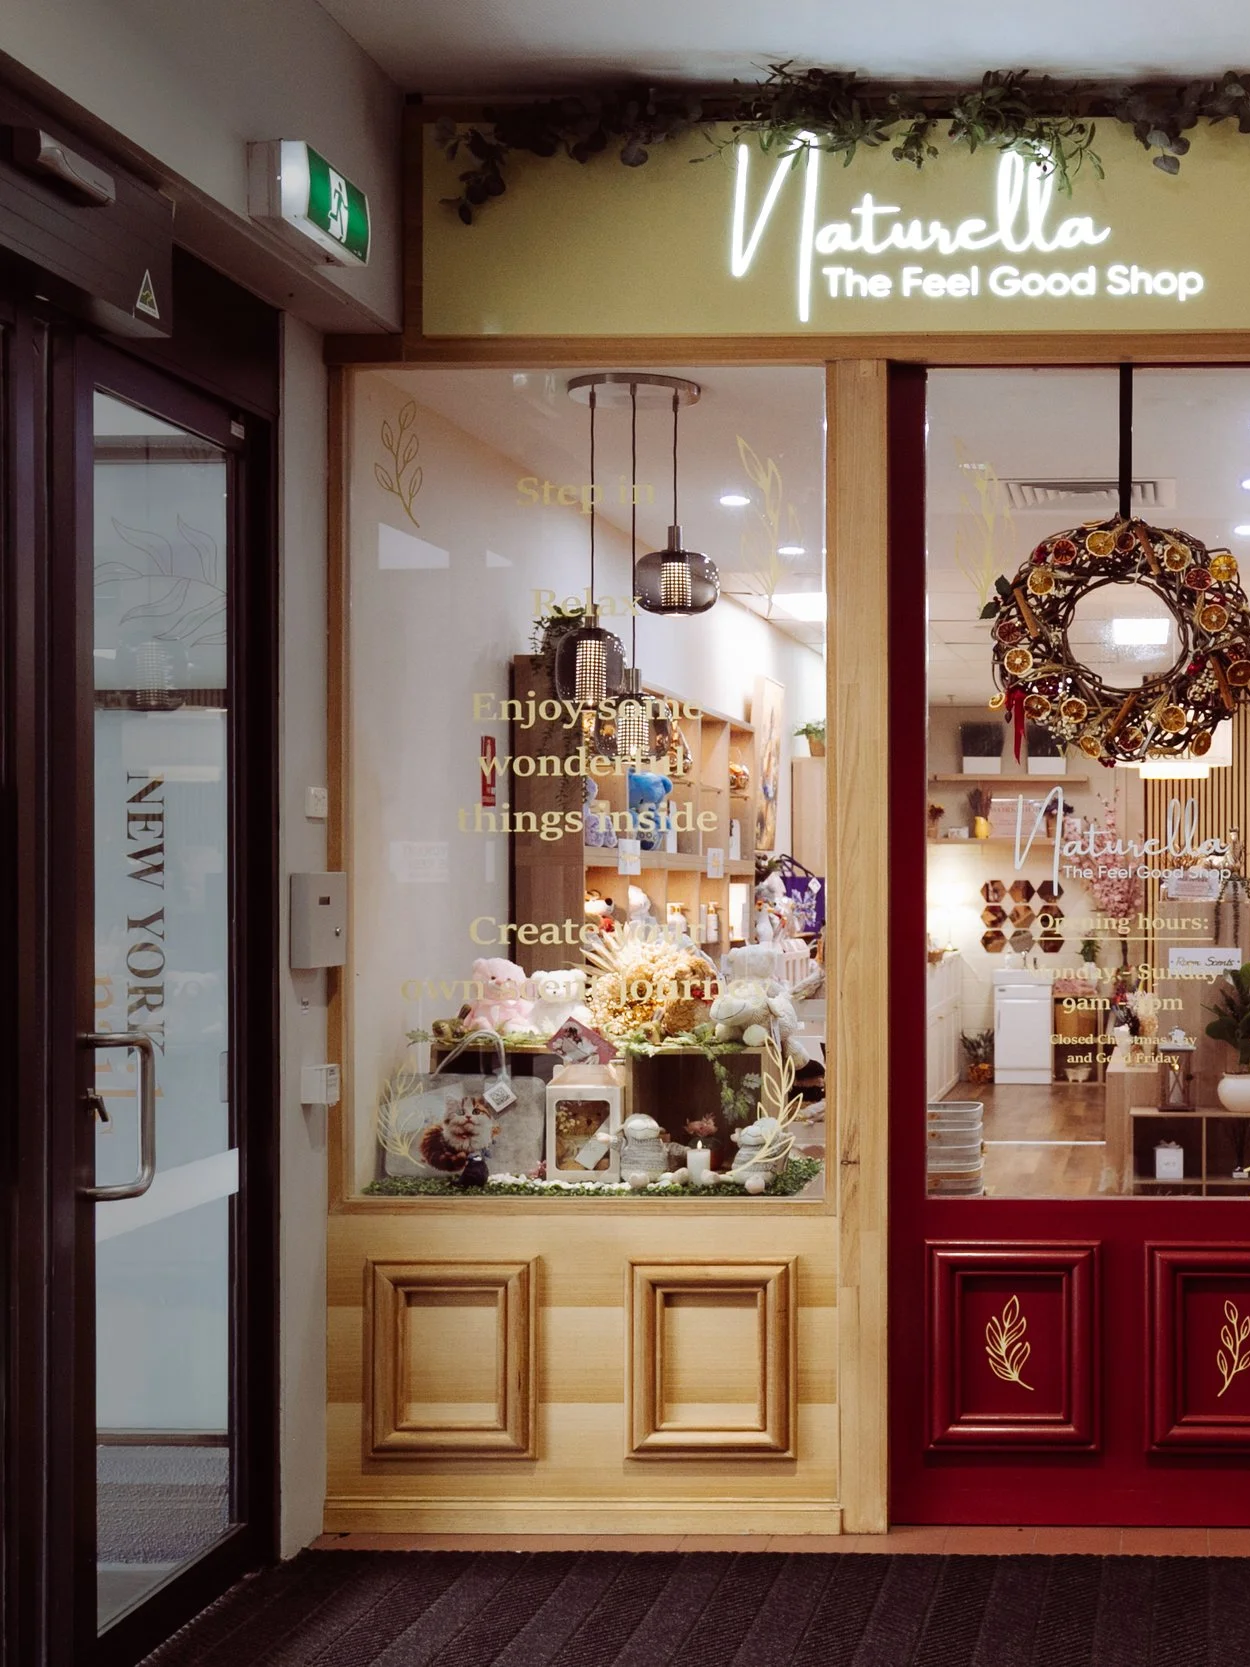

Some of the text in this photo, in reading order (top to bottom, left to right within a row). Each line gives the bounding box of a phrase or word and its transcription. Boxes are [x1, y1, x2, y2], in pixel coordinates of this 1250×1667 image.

[731, 131, 1112, 323] Naturella
[822, 264, 1205, 301] The Feel Good Shop
[516, 475, 656, 514] Step in
[530, 587, 643, 617] Relax
[472, 690, 705, 729] Enjoy some
[477, 746, 687, 777] wonderful
[457, 802, 718, 841] things inside
[1015, 786, 1230, 896] Naturella
[1063, 865, 1231, 883] The Feel Good Shop
[126, 771, 165, 1058] NEW YORK
[1037, 912, 1209, 934] Opning hours:
[469, 916, 600, 945] Create
[1138, 963, 1218, 984] Sunday
[400, 977, 486, 1001] own
[1062, 997, 1111, 1014] 9am
[1133, 997, 1183, 1014] pm
[1050, 1033, 1094, 1045] Closed
[1172, 1034, 1197, 1048] ay
[1067, 1052, 1179, 1067] and God Friday
